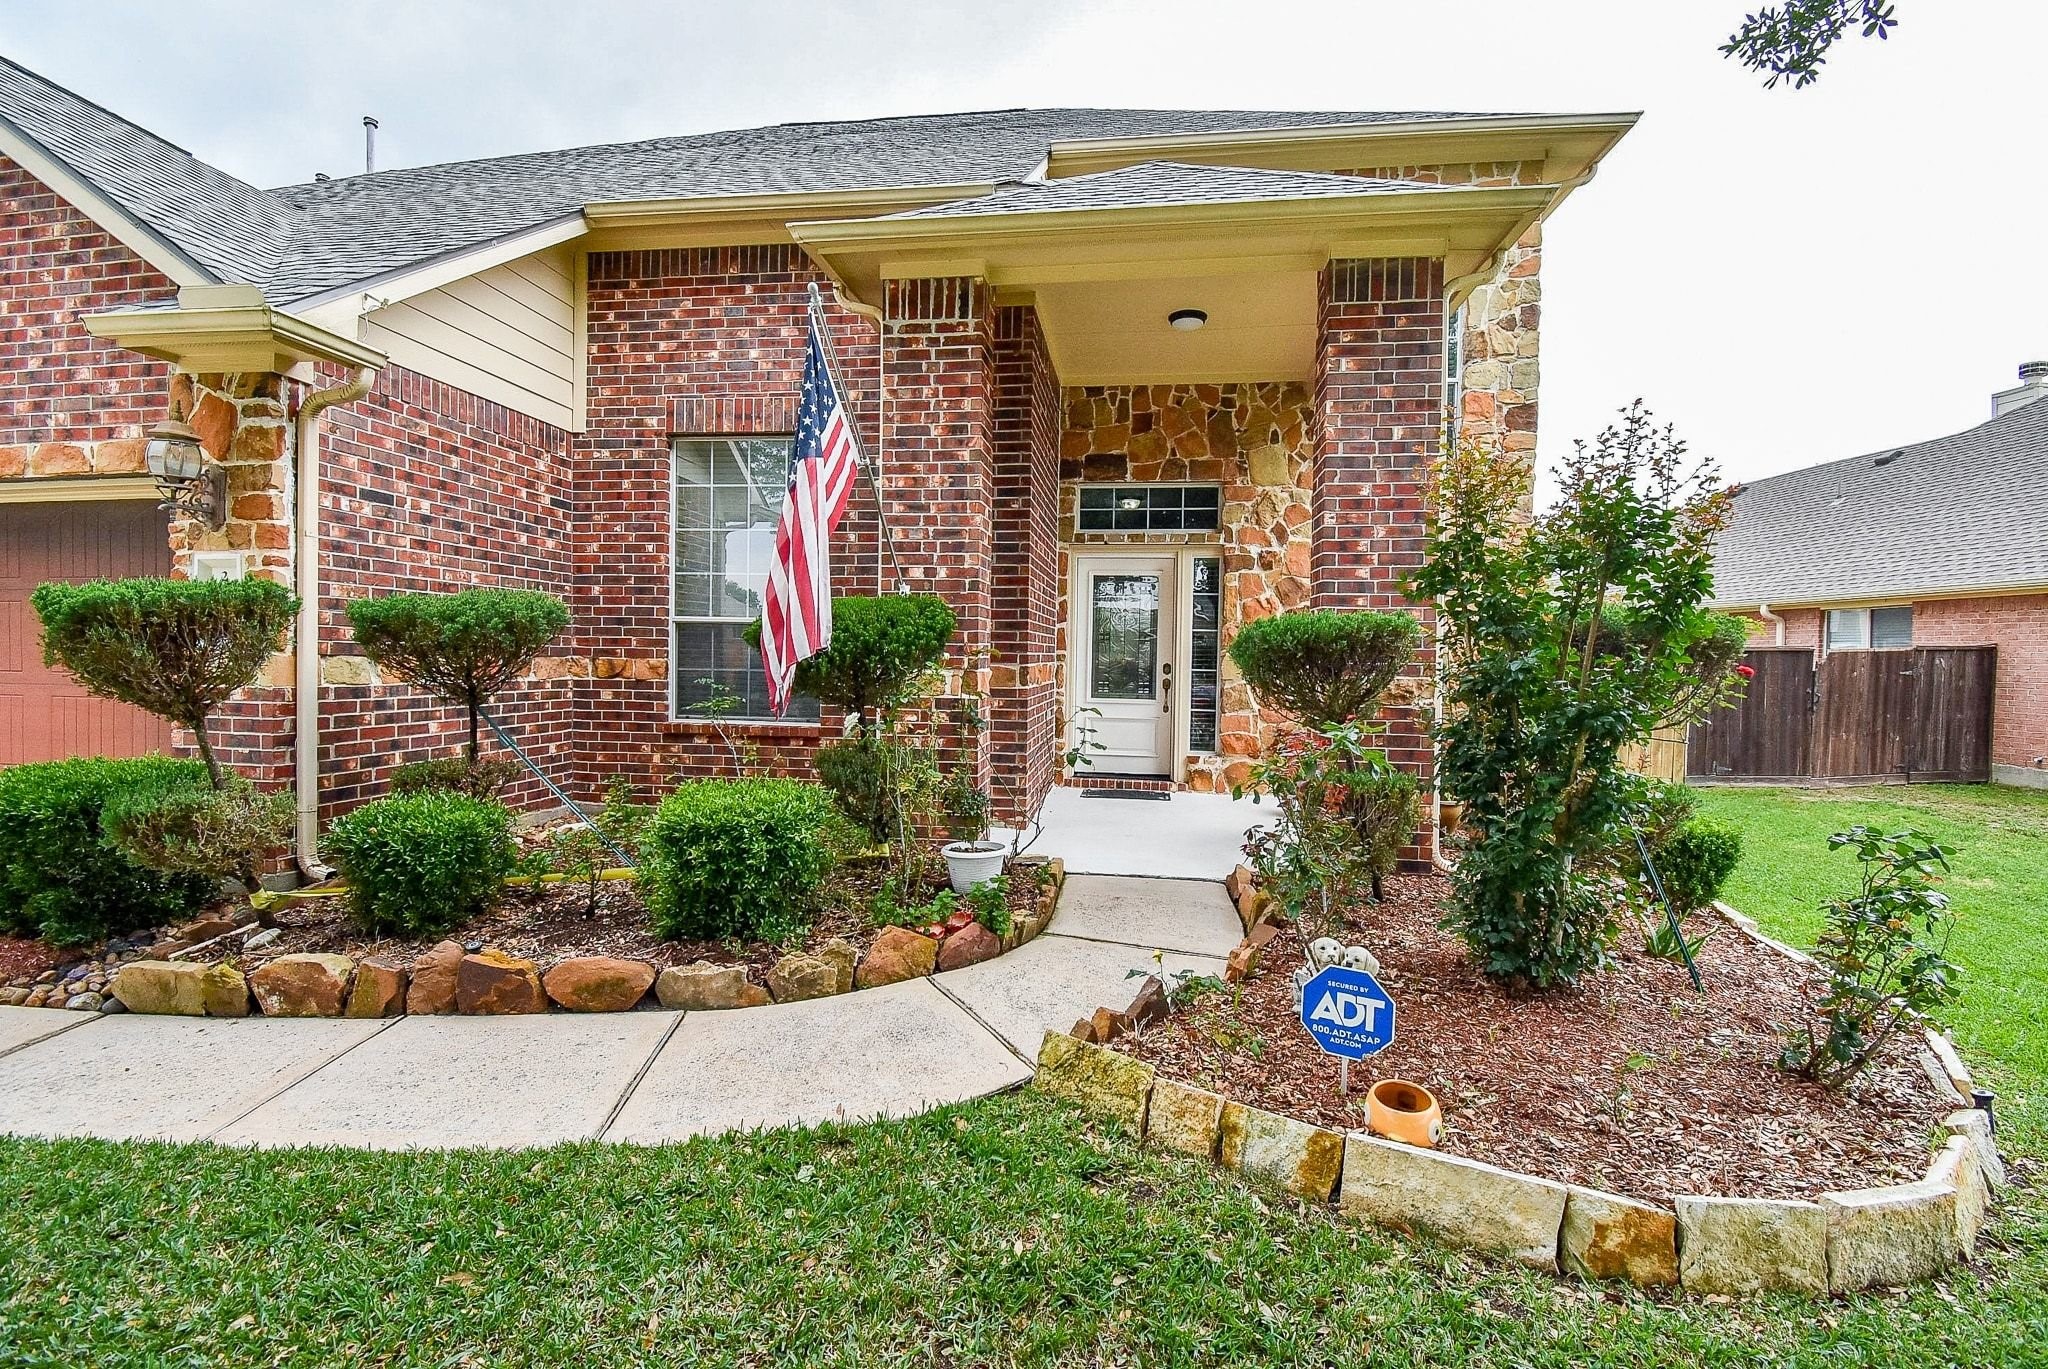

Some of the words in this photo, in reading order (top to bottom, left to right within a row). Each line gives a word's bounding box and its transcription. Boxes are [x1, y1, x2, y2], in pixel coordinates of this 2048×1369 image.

[1328, 980, 1358, 992] SECURED
[1360, 985, 1369, 993] BY
[1310, 990, 1385, 1033] ADT
[1312, 1023, 1381, 1045] 800.ADT.ASAP
[1330, 1037, 1362, 1049] ADT.COM
